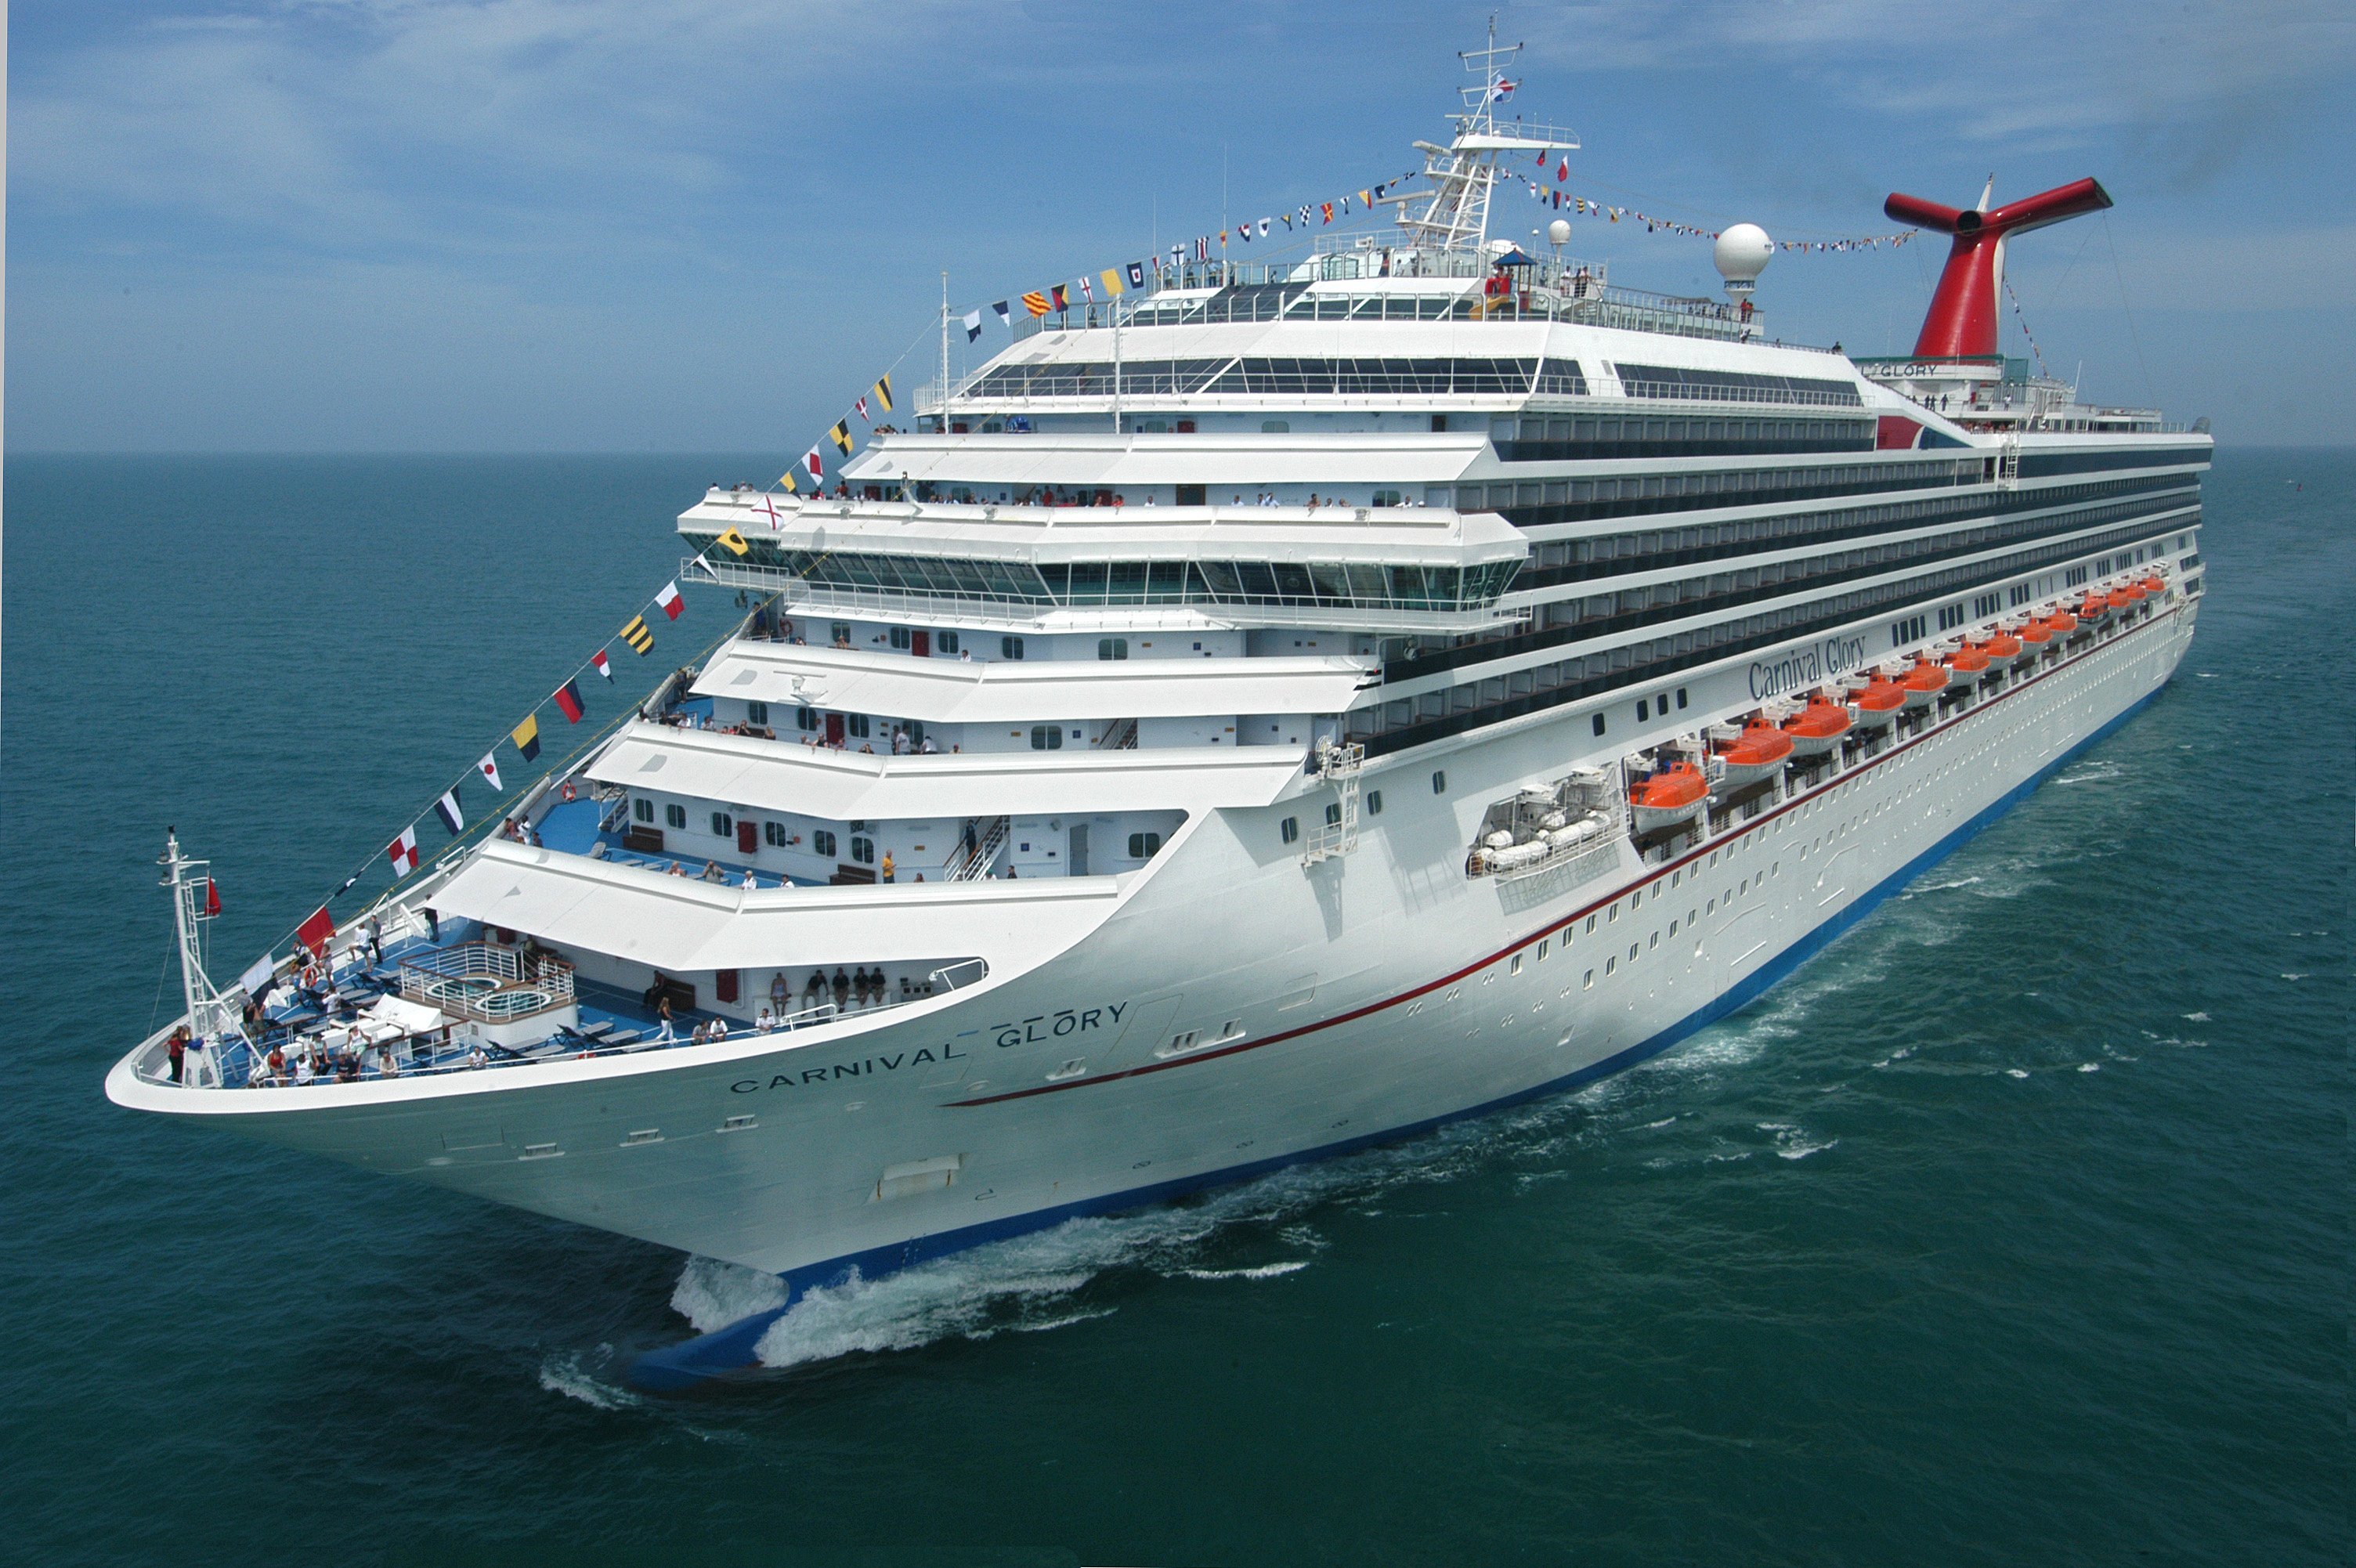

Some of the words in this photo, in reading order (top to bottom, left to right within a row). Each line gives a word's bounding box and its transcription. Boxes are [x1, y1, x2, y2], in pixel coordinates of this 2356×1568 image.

[1881, 364, 1938, 377] GLORY
[1749, 642, 1822, 700] Carnival
[1826, 635, 1866, 674] Glory
[730, 1043, 967, 1094] CARNIVAL
[996, 1000, 1129, 1048] GLORY
